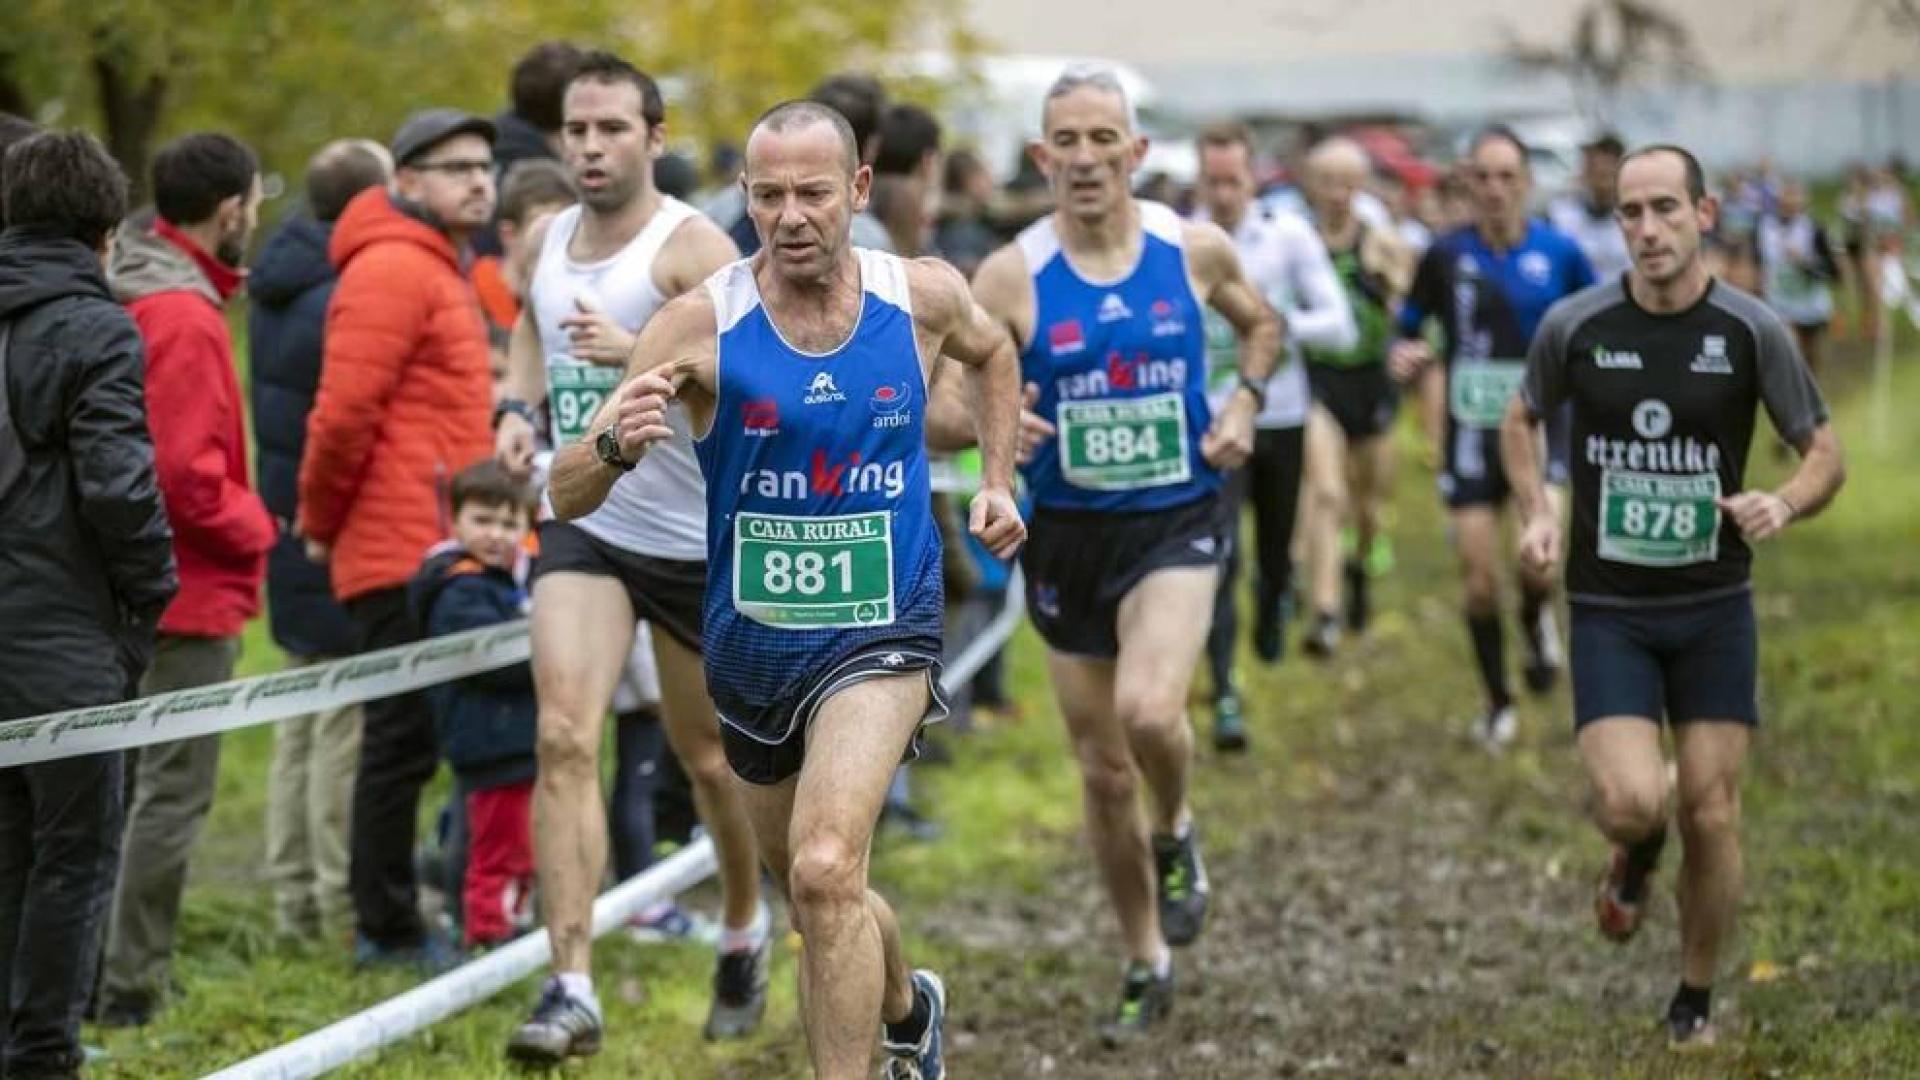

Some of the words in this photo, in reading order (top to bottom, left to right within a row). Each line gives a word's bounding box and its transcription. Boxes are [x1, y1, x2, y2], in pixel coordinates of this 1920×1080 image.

[873, 409, 911, 428] ardoi
[1085, 425, 1160, 463] 884
[741, 447, 905, 499] ranking
[749, 519, 797, 540] CAJA
[803, 519, 877, 540] RURAL
[1622, 499, 1697, 539] 878
[763, 550, 853, 594] 881
